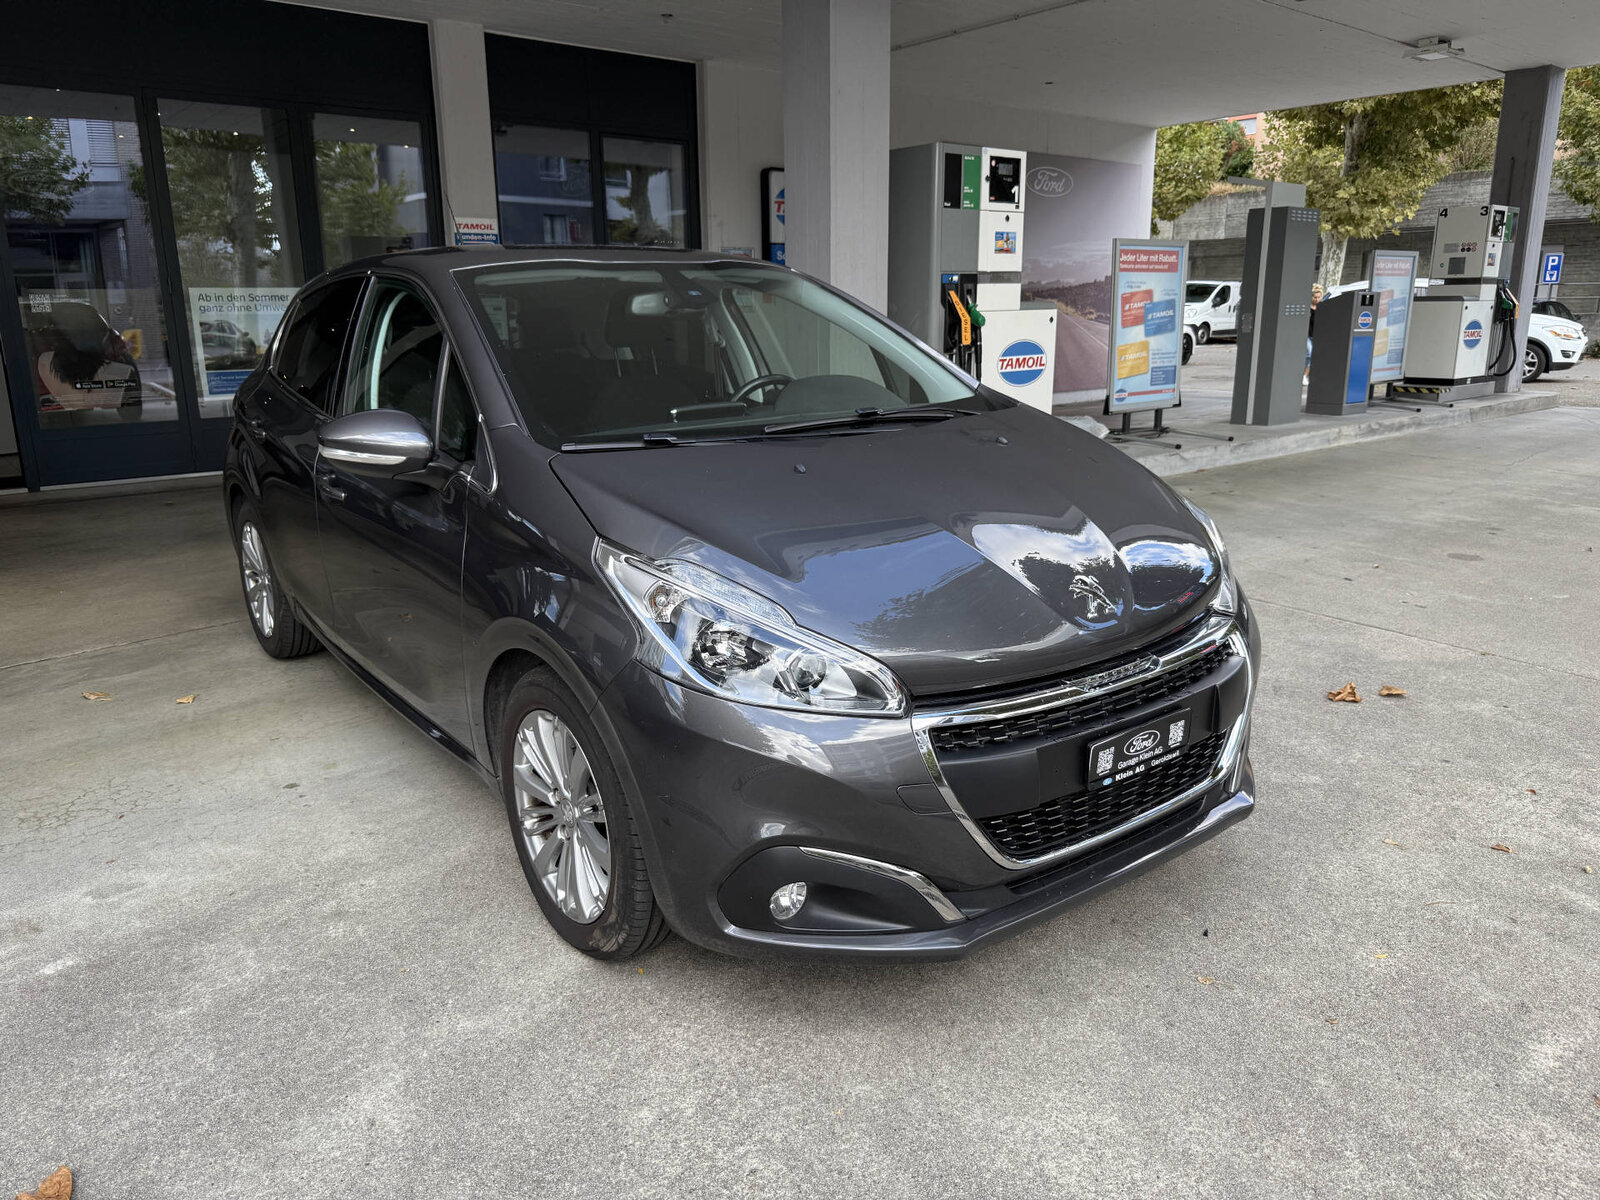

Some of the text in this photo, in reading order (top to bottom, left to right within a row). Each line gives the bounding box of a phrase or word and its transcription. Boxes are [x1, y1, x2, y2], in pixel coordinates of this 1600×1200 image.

[1011, 185, 1019, 203] 1
[774, 200, 786, 214] T
[1439, 208, 1449, 218] 4
[1480, 206, 1489, 216] 3
[457, 223, 494, 231] TAMOIL
[1120, 252, 1136, 262] Jeder
[1136, 253, 1149, 262] Liter
[1149, 254, 1158, 262] mit
[1547, 256, 1559, 271] P
[198, 292, 289, 302] Ab in den Sommer
[199, 304, 224, 313] ganz
[226, 303, 252, 312] ohne
[954, 300, 969, 342] DIESEL
[1463, 330, 1483, 339] TAMOIL
[999, 355, 1046, 371] TAMOIL
[1129, 734, 1155, 753] Ford
[1117, 746, 1164, 770] Garage Klein AG
[1115, 769, 1134, 782] Klein
[1134, 764, 1146, 774] AG
